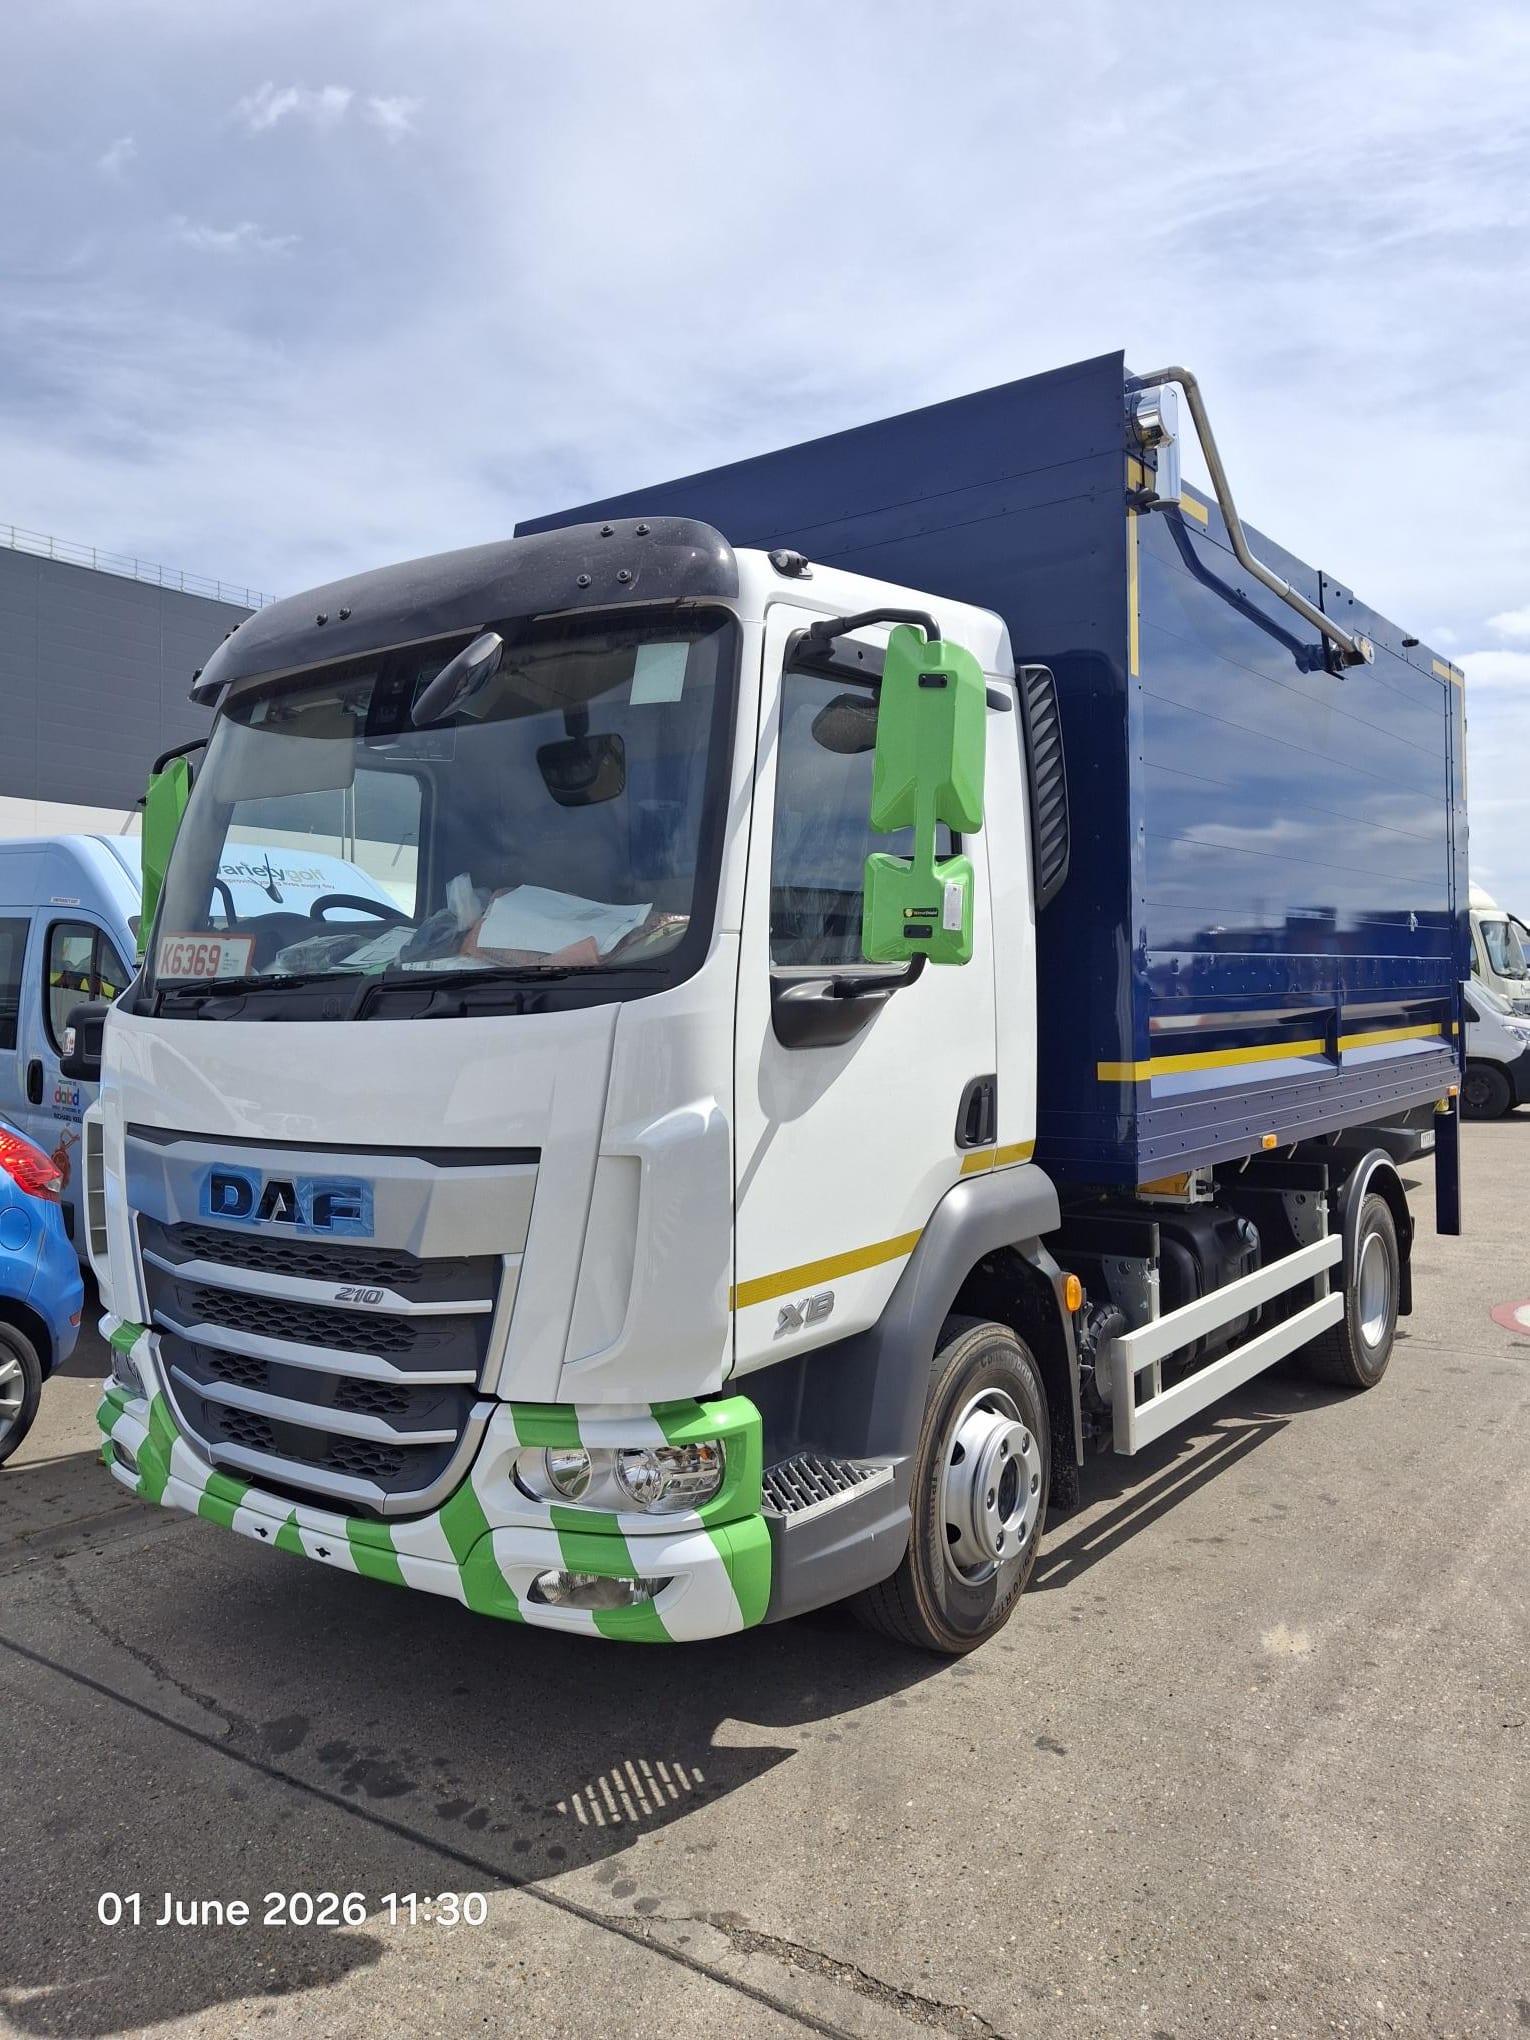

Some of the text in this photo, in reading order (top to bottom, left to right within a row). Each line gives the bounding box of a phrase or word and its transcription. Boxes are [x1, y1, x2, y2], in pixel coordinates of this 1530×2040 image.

[161, 943, 222, 977] K6369
[54, 1085, 80, 1106] dabd
[210, 1172, 363, 1231] DAF
[334, 1286, 385, 1305] 210
